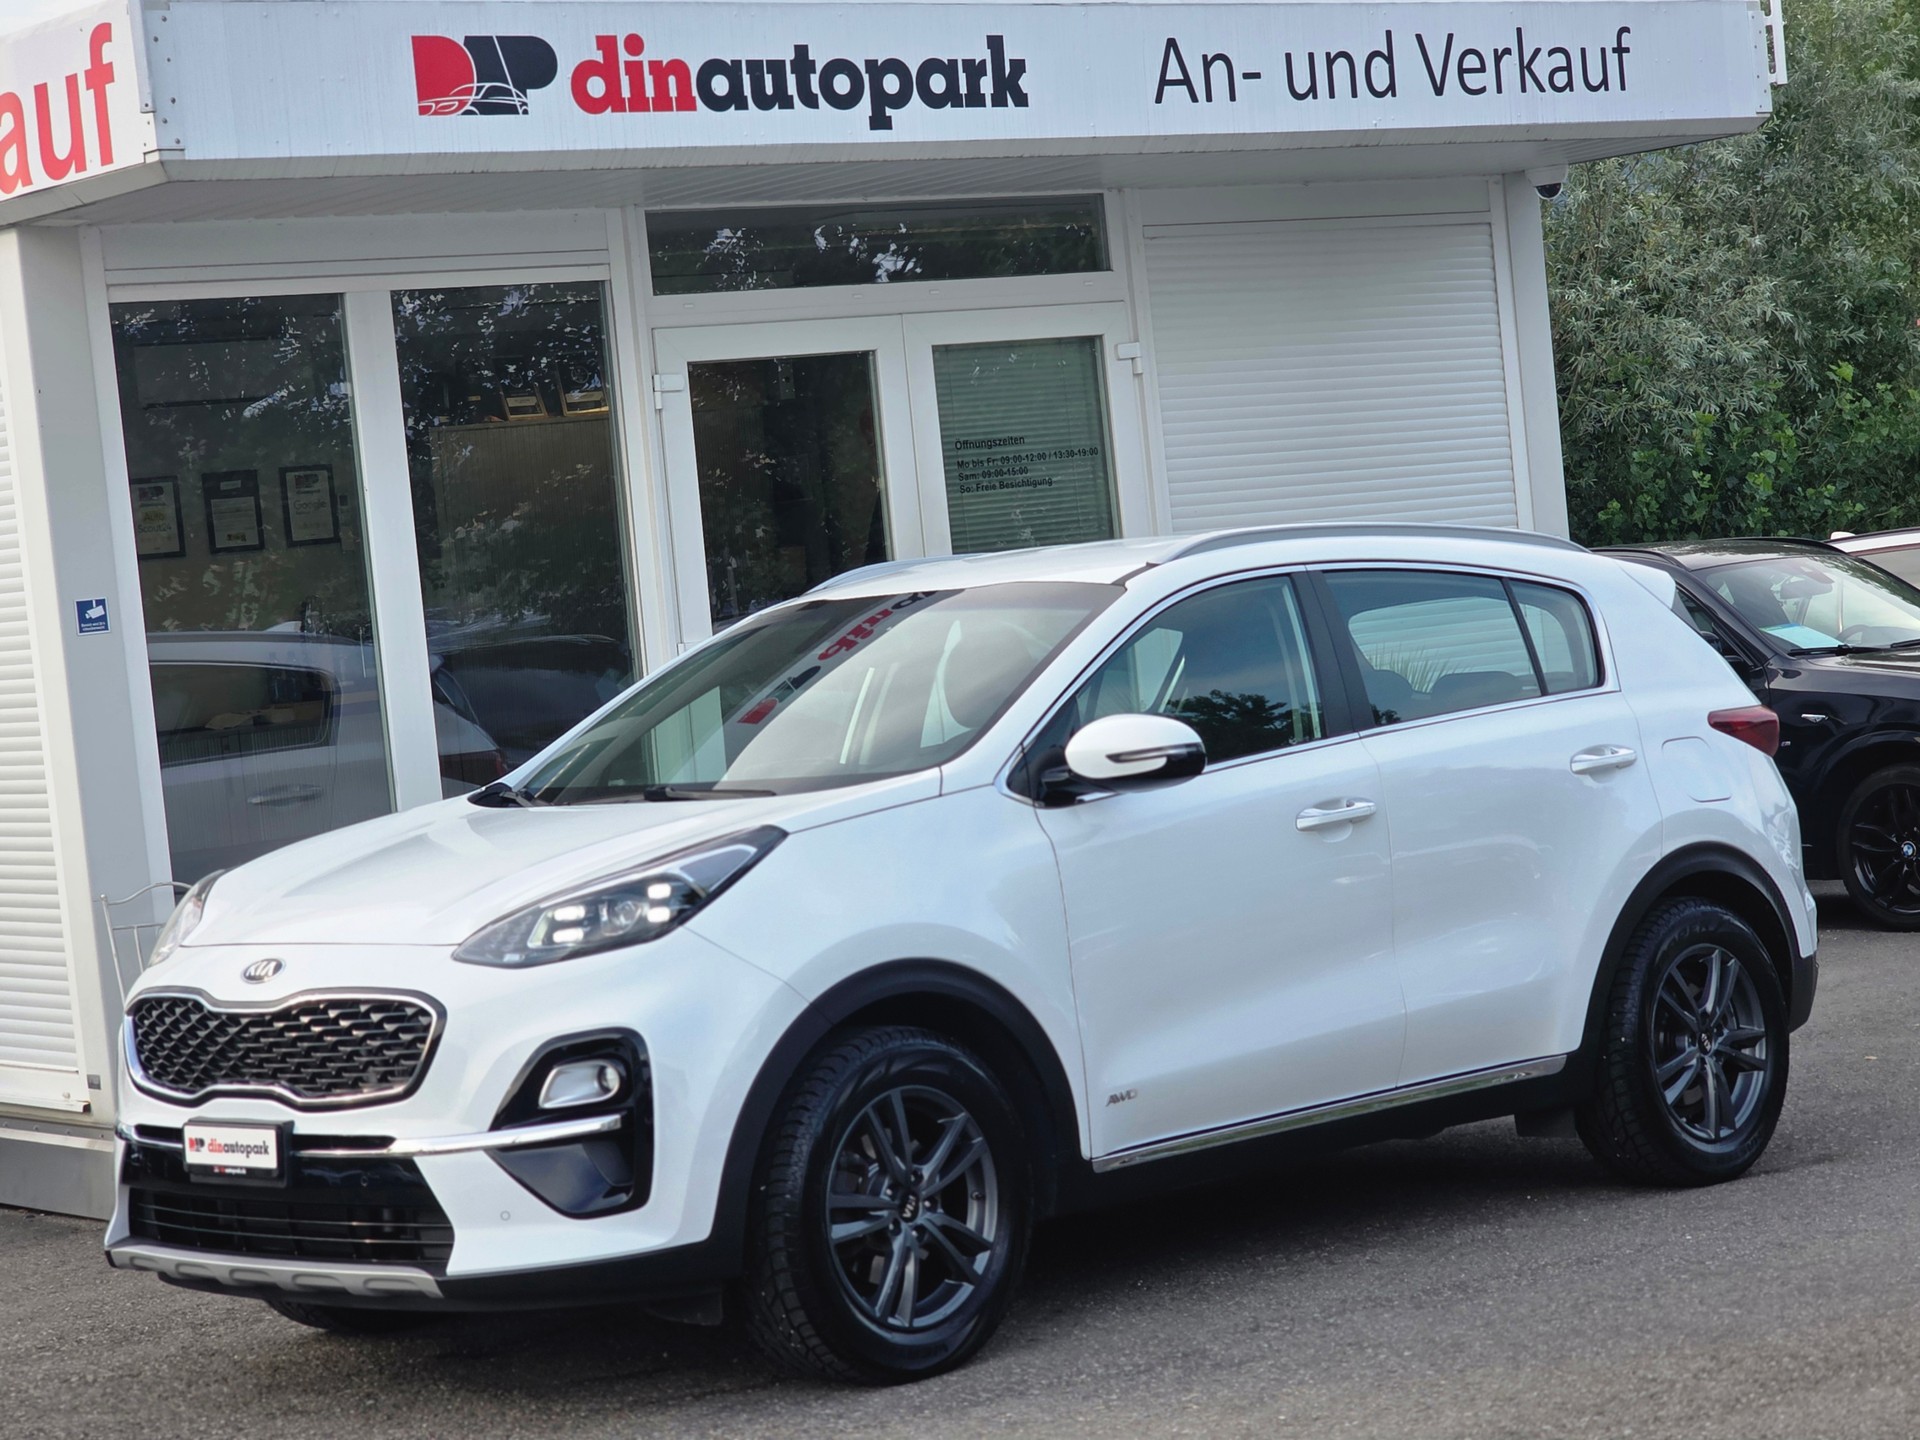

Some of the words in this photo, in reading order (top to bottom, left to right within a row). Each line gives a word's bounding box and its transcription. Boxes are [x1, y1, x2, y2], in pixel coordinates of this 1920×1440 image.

[1154, 36, 1262, 104] An-
[1284, 29, 1397, 101] und
[1415, 26, 1631, 97] Verkauf
[570, 33, 1029, 130] dinautopark
[0, 22, 115, 195] auf
[955, 436, 1025, 450] Öffnungszeiten
[957, 460, 970, 469] Mo
[972, 458, 985, 468] bis
[1000, 452, 1047, 465] 09:00-12:00
[1053, 447, 1099, 460] 13:30-19:00
[958, 472, 980, 481] Sam:
[982, 466, 1029, 479] 09:00-15:00
[960, 484, 974, 494] So:
[976, 482, 997, 492] Freie
[999, 477, 1053, 490] Besichtigung
[208, 1138, 270, 1159] dinautopark
